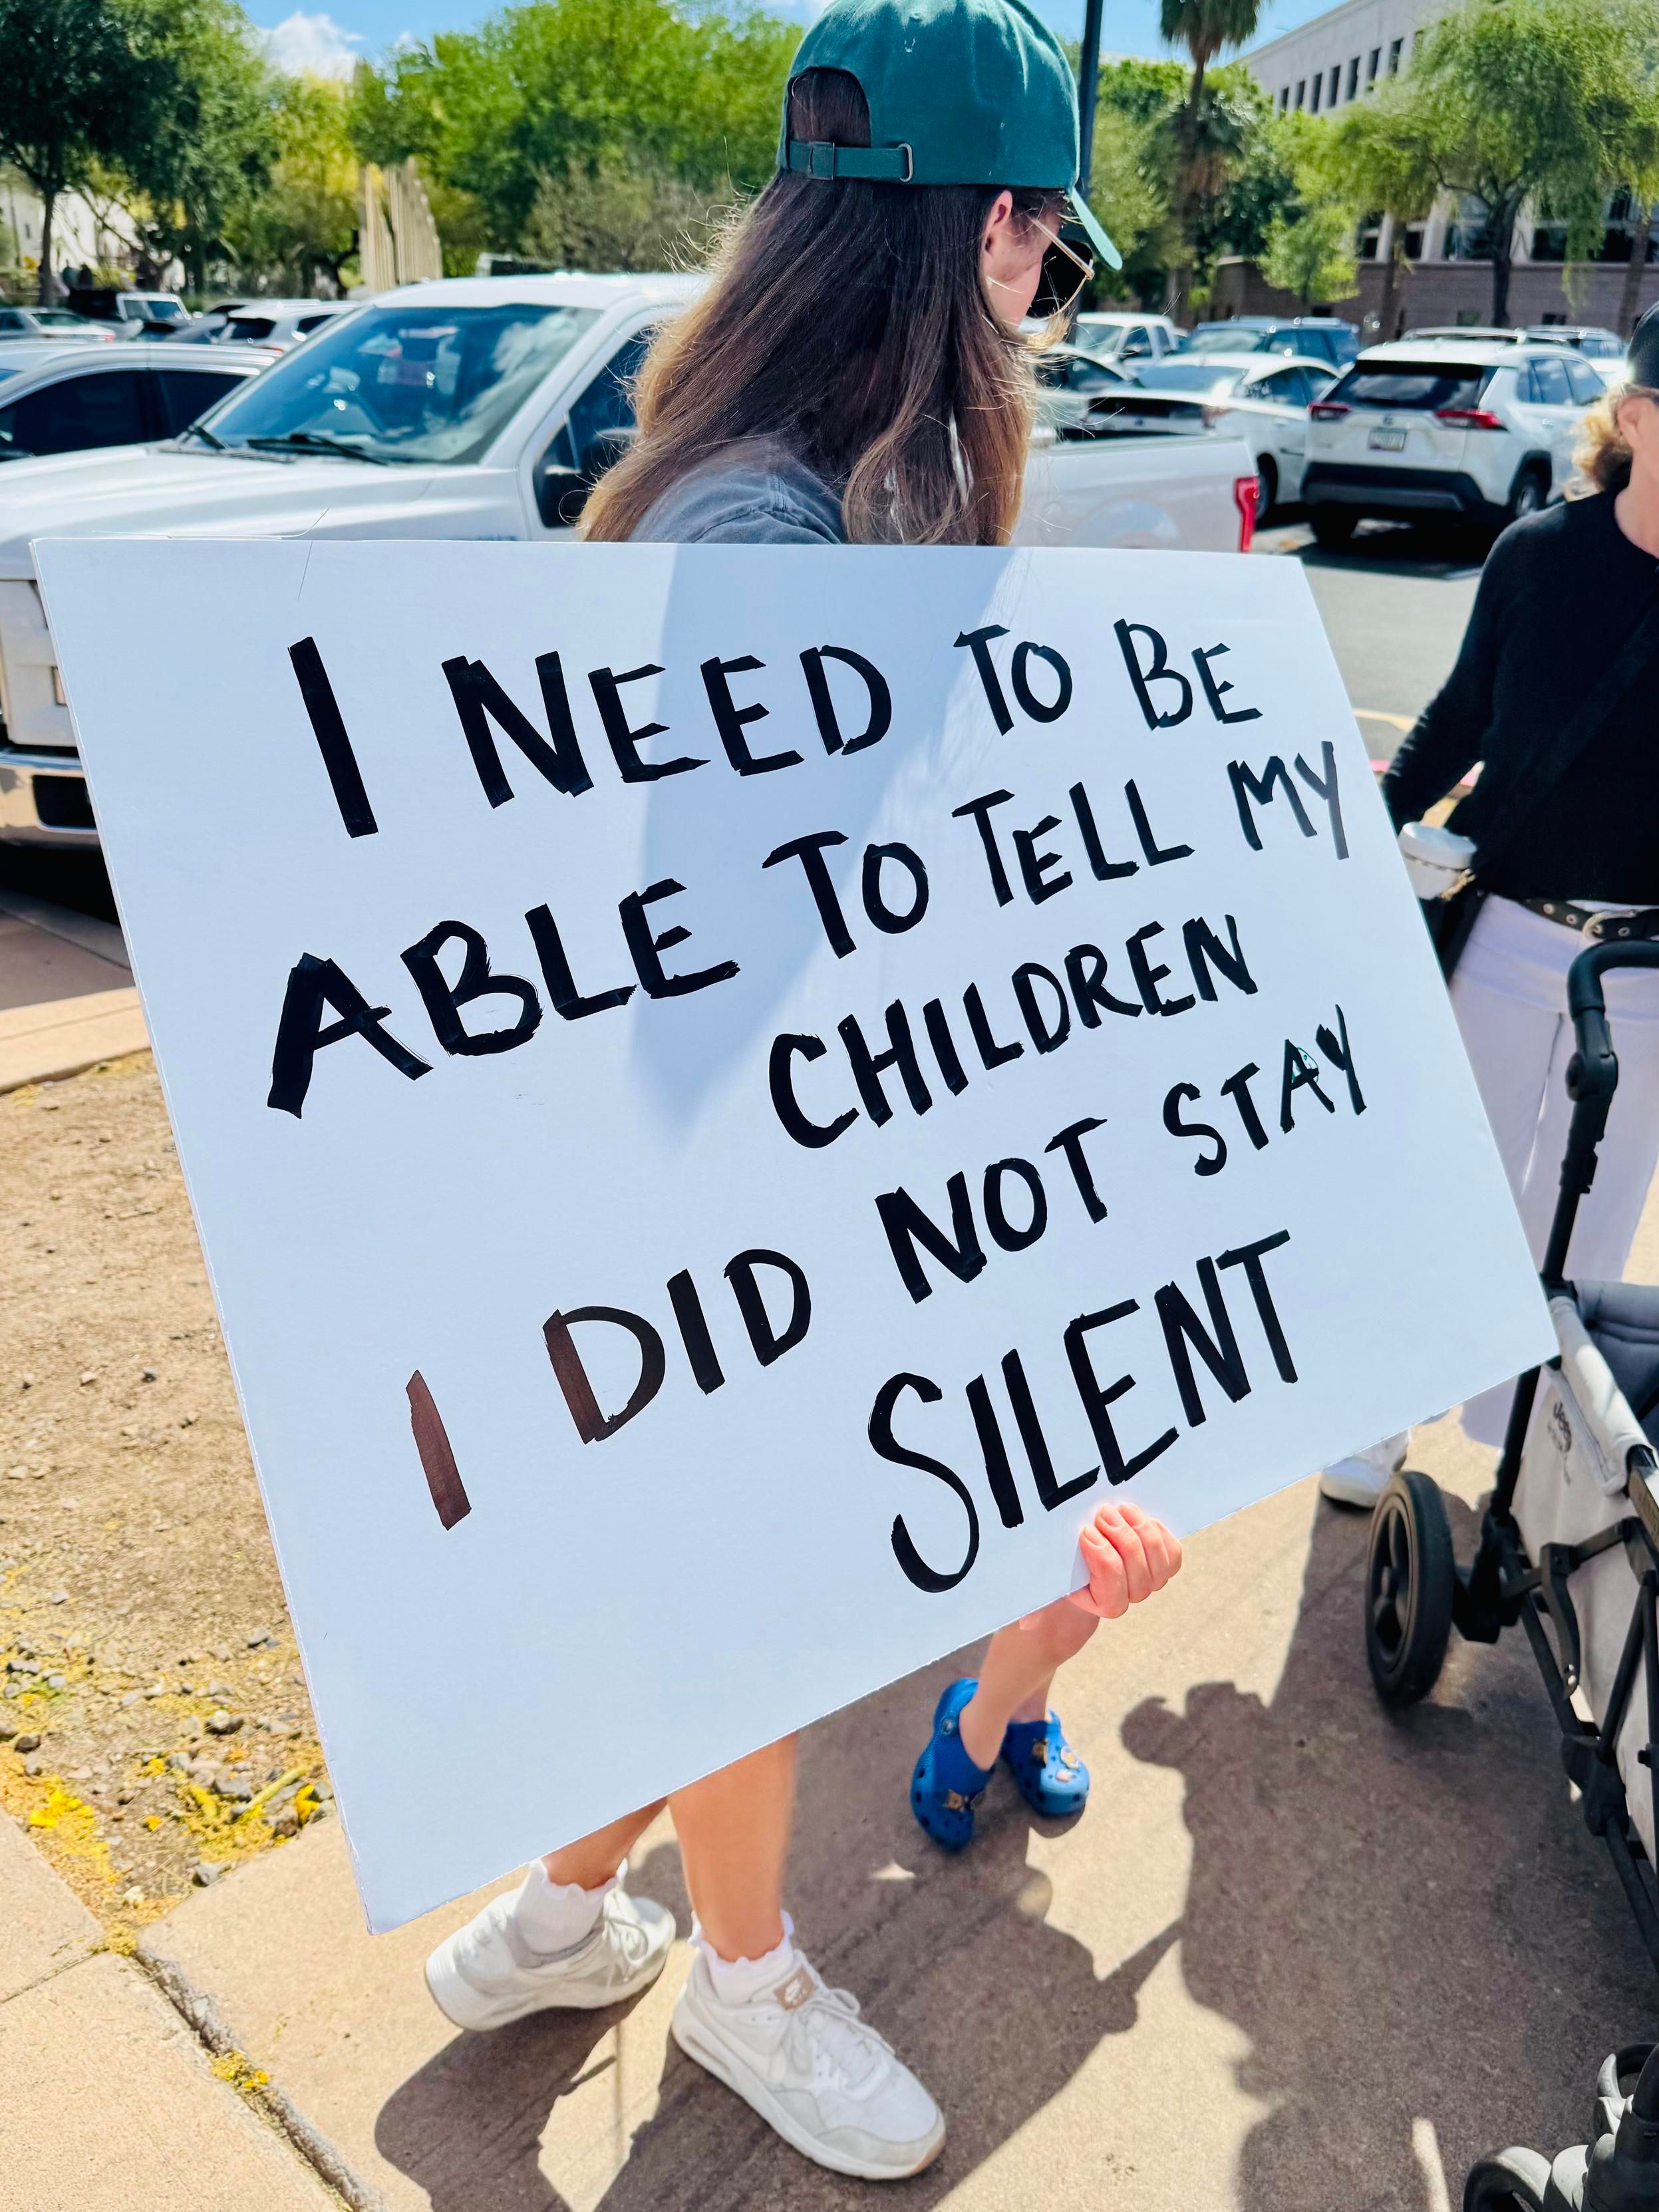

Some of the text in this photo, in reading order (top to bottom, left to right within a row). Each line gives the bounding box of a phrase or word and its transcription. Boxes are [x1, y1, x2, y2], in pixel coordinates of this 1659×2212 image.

[288, 617, 1263, 838] I NEED TO BE
[267, 740, 1350, 1119] ABLE TO TELL MY
[769, 913, 1258, 1150] CHILDREN
[404, 1003, 1368, 1532] I DID NOT STAY
[868, 1228, 1299, 1594] SILENT
